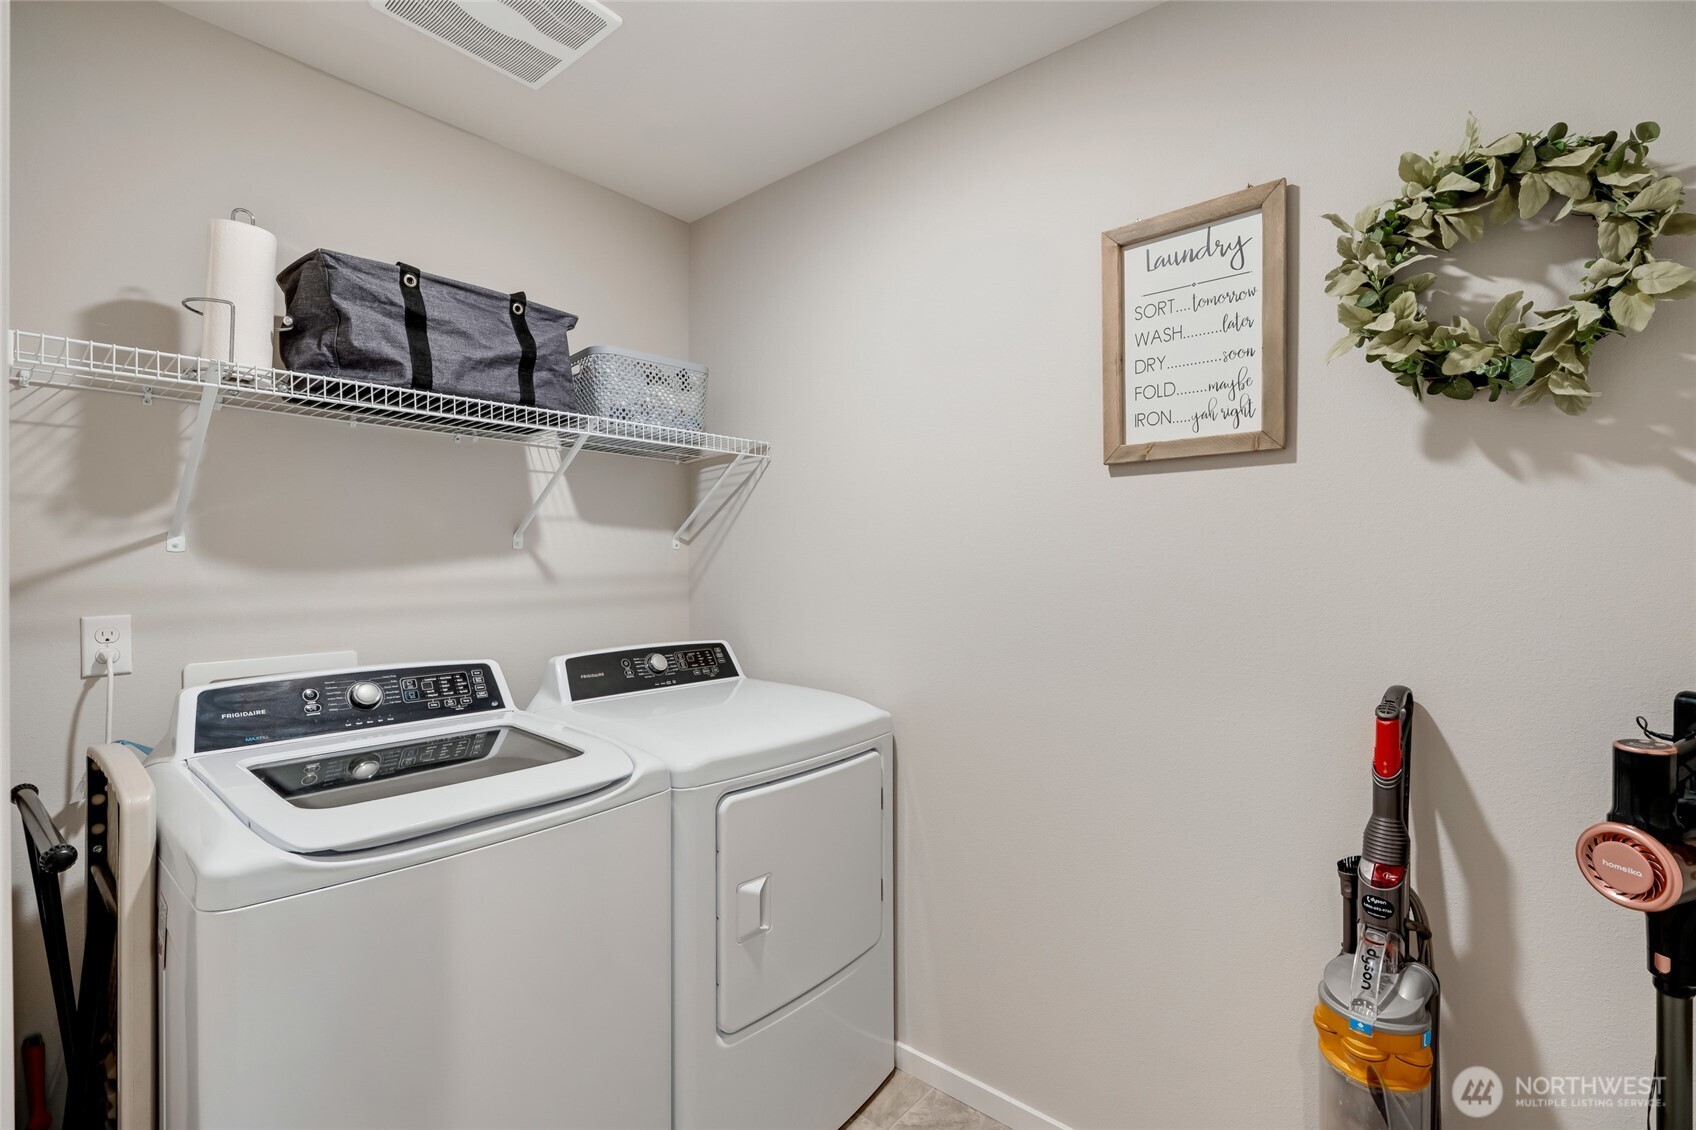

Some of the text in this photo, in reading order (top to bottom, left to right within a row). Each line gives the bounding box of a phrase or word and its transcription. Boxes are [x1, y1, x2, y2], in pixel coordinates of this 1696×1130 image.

[1146, 226, 1253, 272] Laundry
[1220, 393, 1256, 429] right
[221, 709, 267, 719] FRIGIDAIRE
[1361, 948, 1381, 990] dyson
